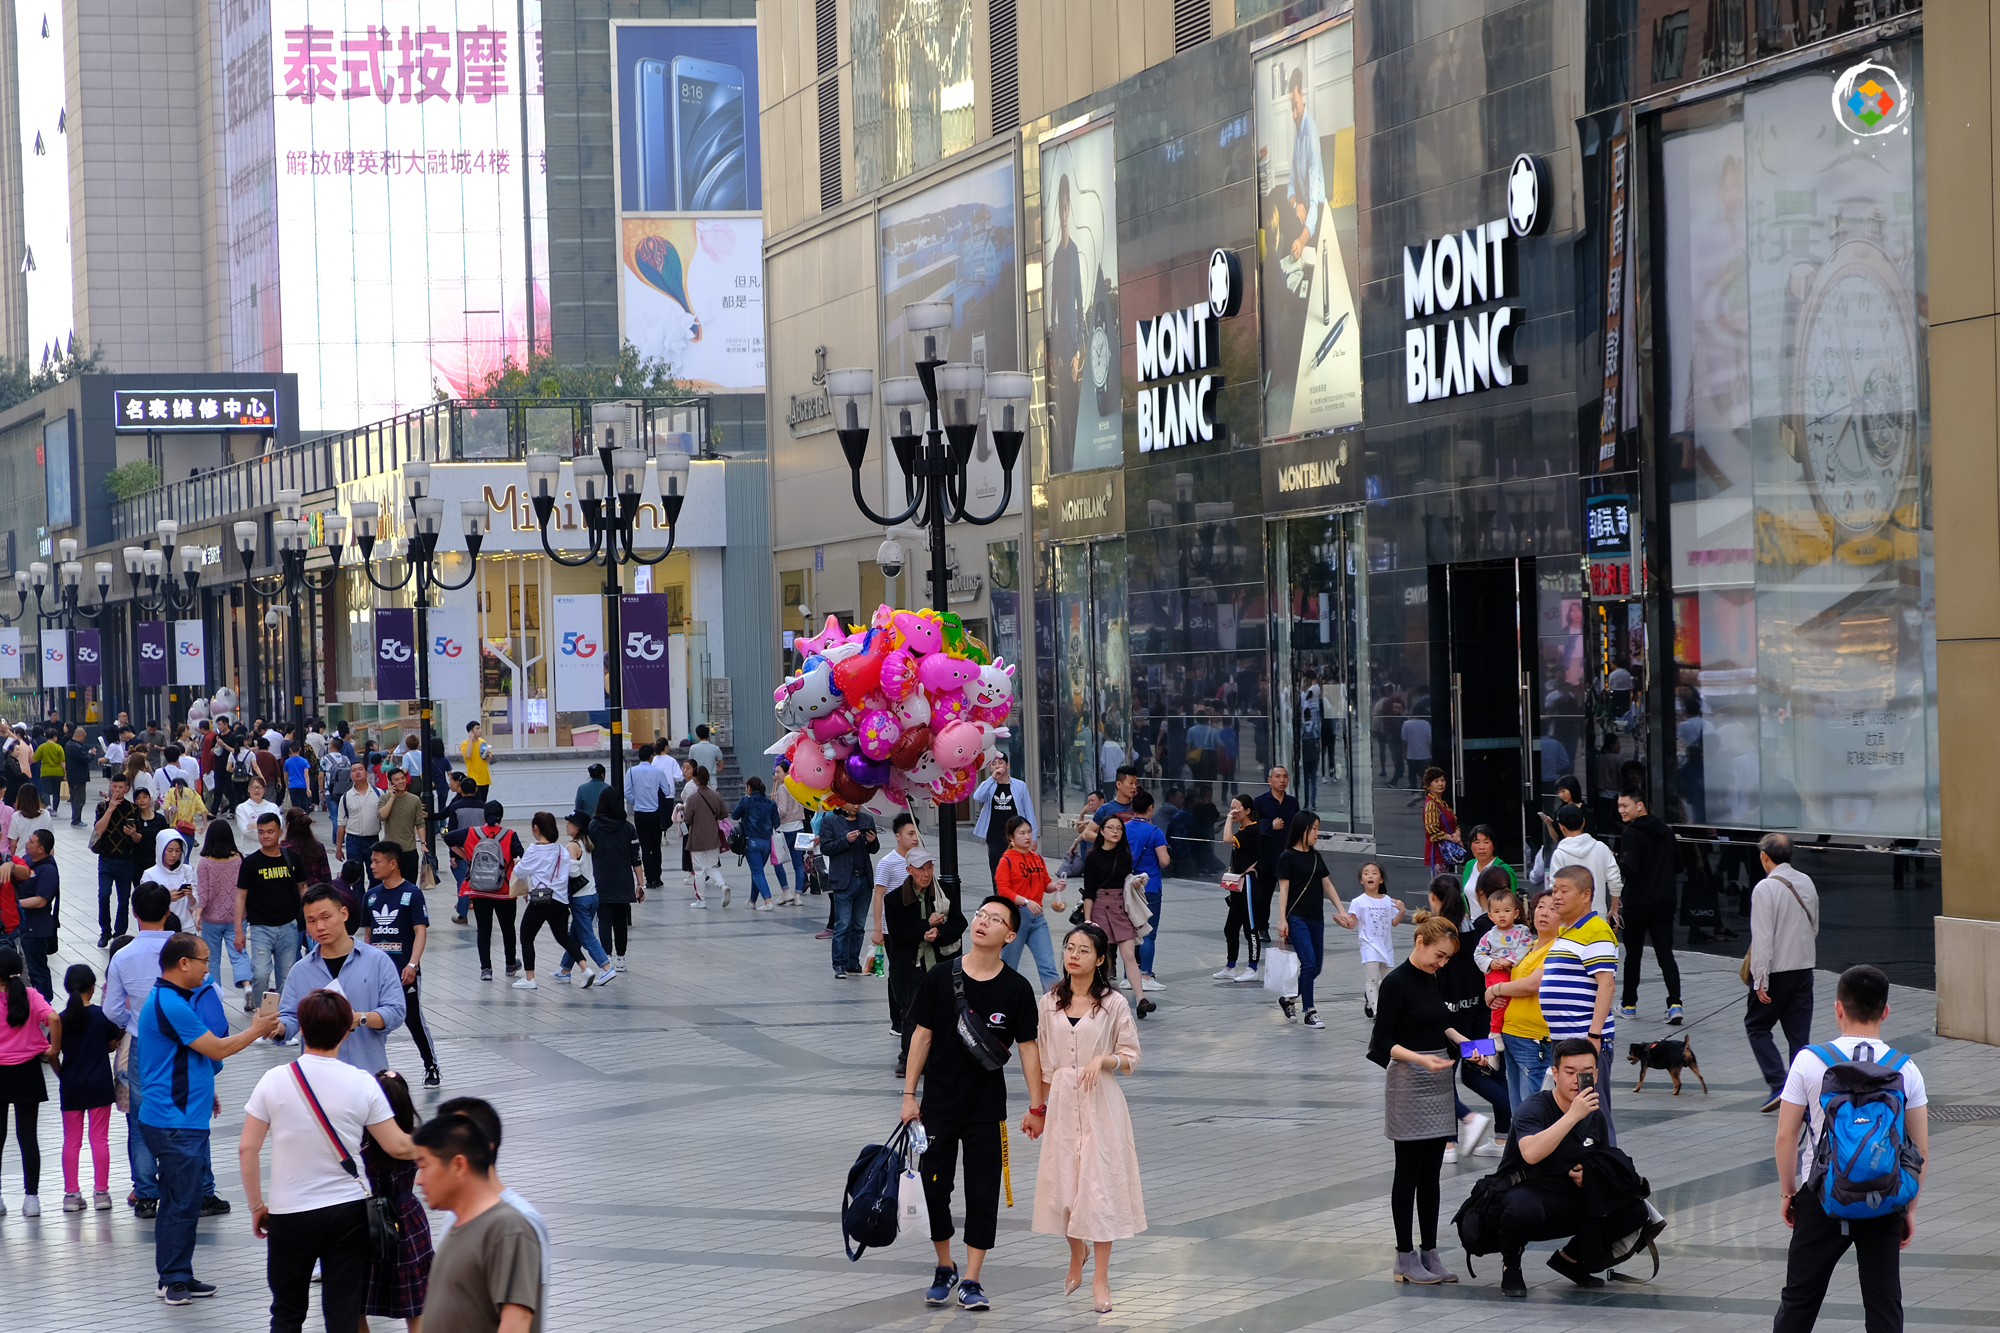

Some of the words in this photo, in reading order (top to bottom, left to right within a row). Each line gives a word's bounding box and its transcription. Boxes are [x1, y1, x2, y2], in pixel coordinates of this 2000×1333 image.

[283, 24, 509, 104] 泰式按摩
[681, 83, 703, 99] 8:16
[286, 148, 511, 176] 解放碑英利大融城4楼
[1403, 217, 1509, 320] MONT
[734, 275, 763, 288] 但凡
[722, 295, 764, 308] 都是一
[1136, 301, 1210, 382] MONT
[1405, 306, 1513, 404] BLANC
[125, 397, 268, 419] 名表维修中心
[1137, 374, 1213, 453] BLANC
[1278, 458, 1341, 493] MONTBLANC
[1061, 494, 1107, 522] MONTBLANC
[1, 644, 17, 656] 5G
[45, 648, 63, 662] 5G
[77, 647, 98, 662] 5G
[141, 643, 164, 660] 5G
[179, 641, 200, 657] 5G
[379, 639, 411, 662] 5G
[434, 636, 462, 658] 5G
[561, 632, 597, 658] 5G
[625, 632, 665, 661] 5G
[372, 925, 399, 935] adidas
